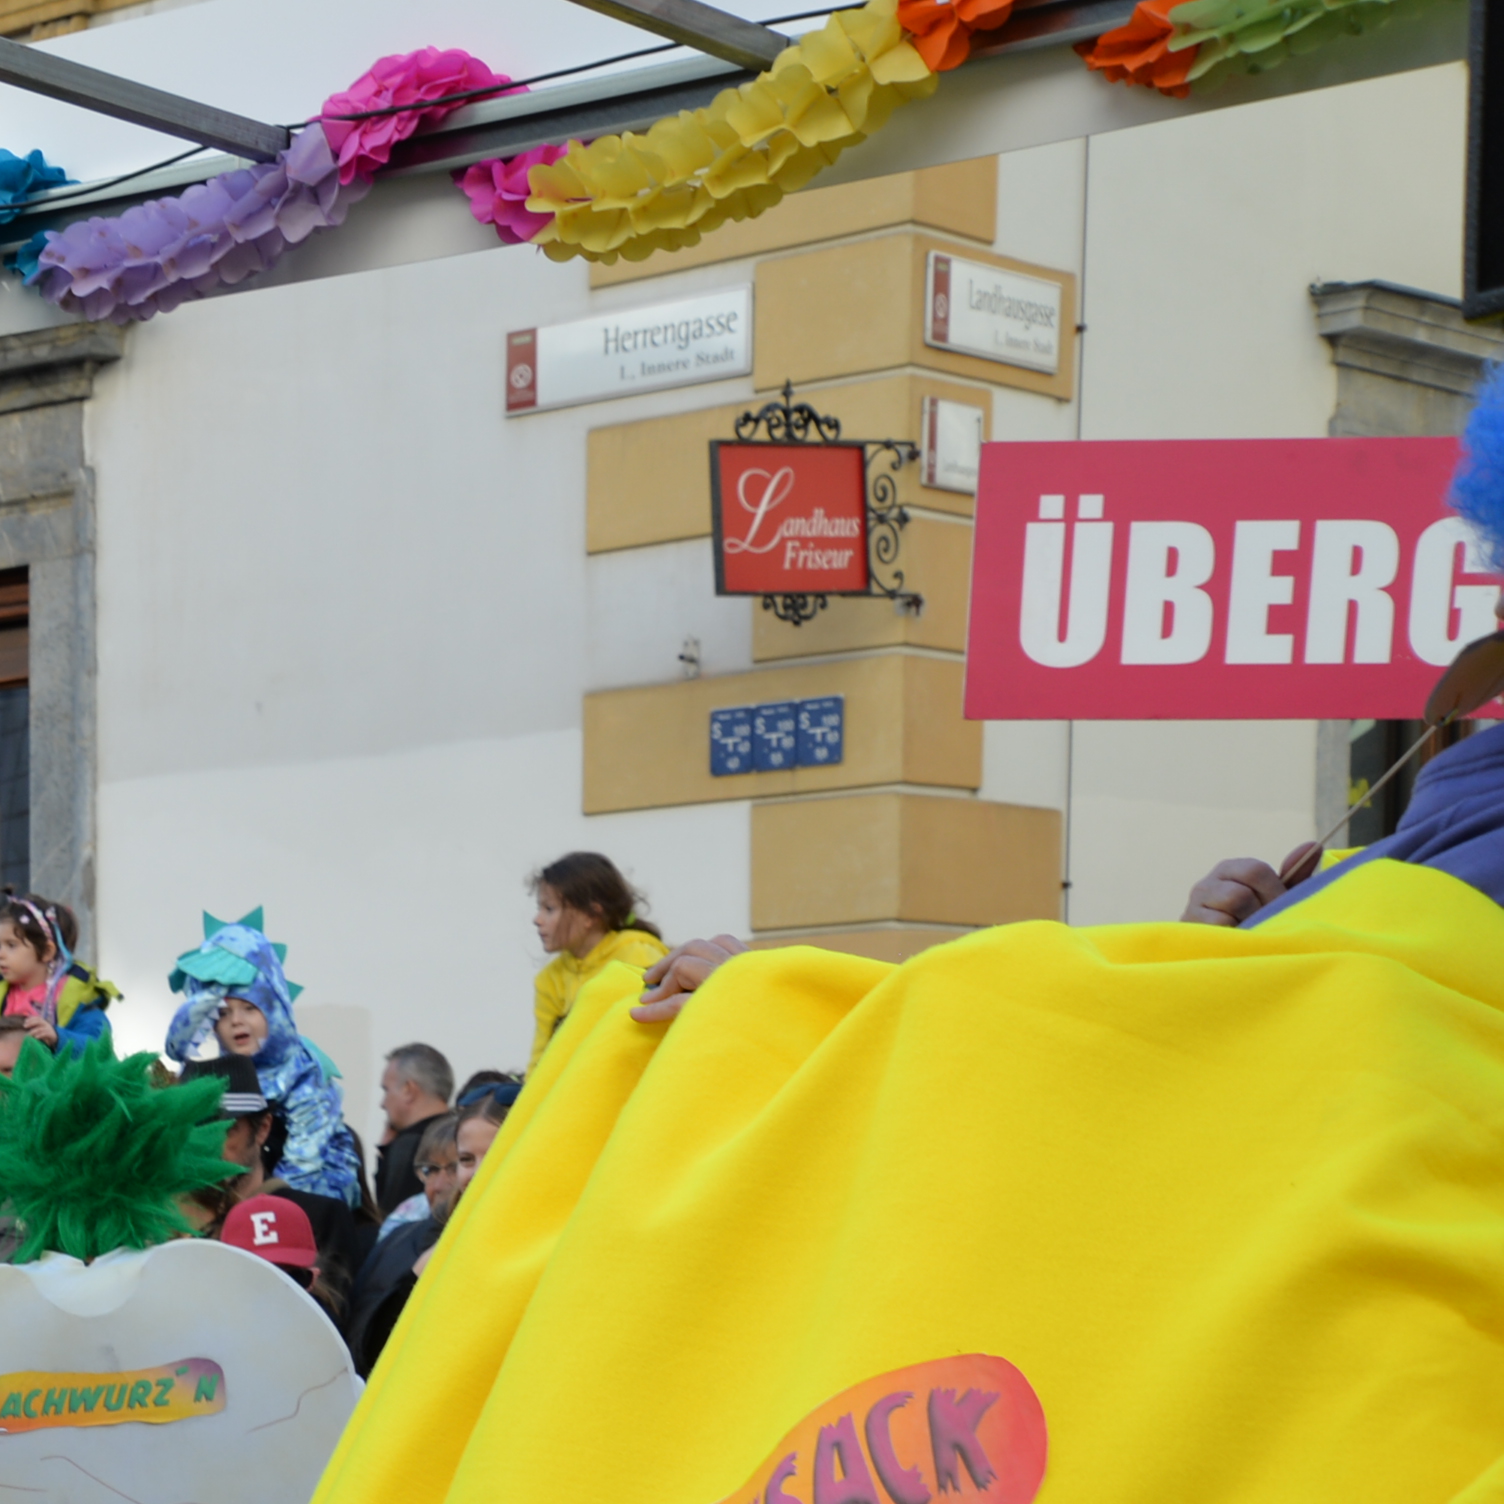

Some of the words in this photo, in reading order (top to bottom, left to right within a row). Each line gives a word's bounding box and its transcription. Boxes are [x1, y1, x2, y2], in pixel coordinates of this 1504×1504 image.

[968, 278, 1056, 330] Landhausgasse
[602, 310, 738, 356] Herrengasse
[641, 357, 690, 376] Innere
[695, 347, 736, 366] Stadt
[723, 466, 861, 554] Landhaus
[783, 540, 854, 570] Friseur
[250, 1211, 279, 1246] E
